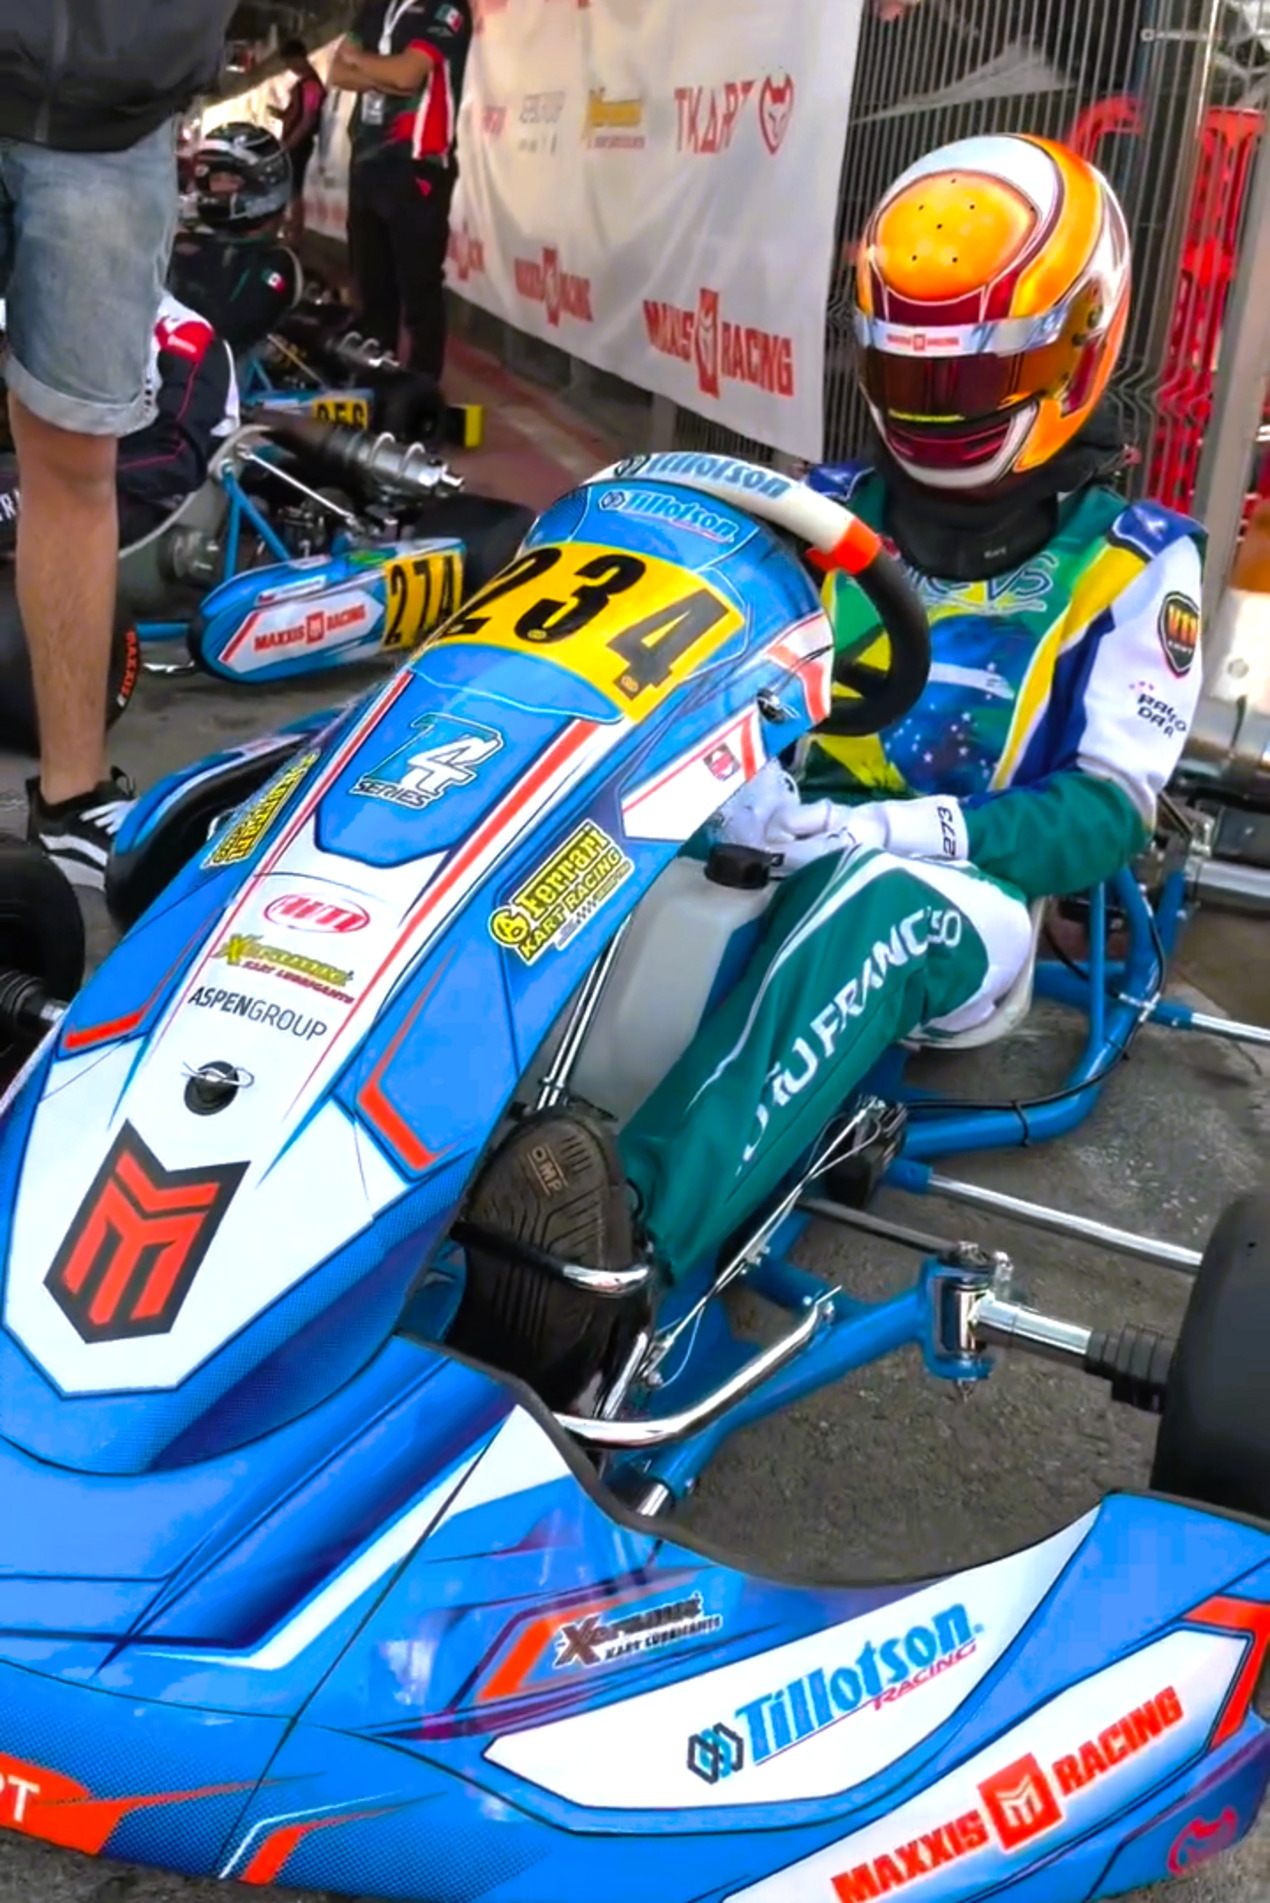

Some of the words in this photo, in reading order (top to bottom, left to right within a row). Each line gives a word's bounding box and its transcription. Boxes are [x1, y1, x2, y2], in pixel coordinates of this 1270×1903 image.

[440, 547, 730, 701] 234
[358, 780, 430, 807] SERIES
[520, 906, 567, 959] KART
[563, 848, 621, 912] RACING
[187, 985, 328, 1041] ASPENGROUP
[532, 1146, 562, 1191] OMP
[734, 1603, 972, 1764] Tillotson
[873, 1643, 977, 1711] RACING
[830, 1808, 990, 1903] MAXXIS
[1051, 1684, 1184, 1797] RACING
